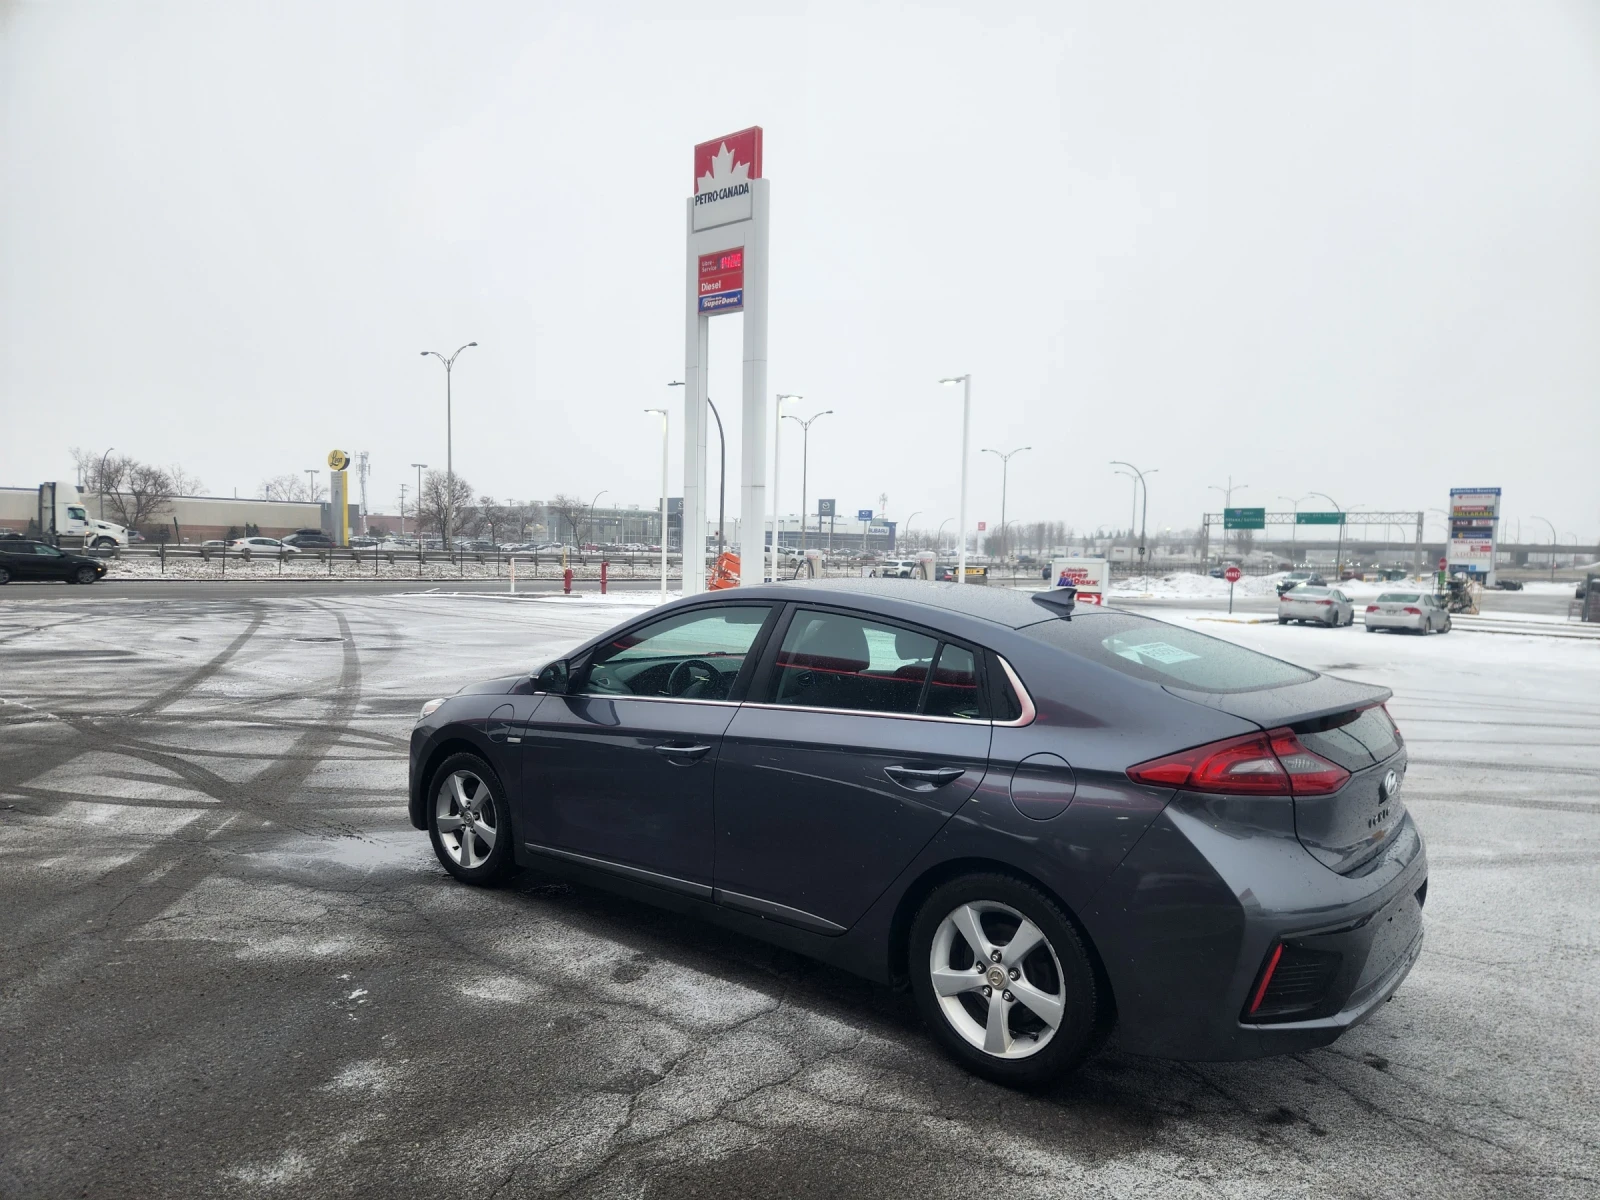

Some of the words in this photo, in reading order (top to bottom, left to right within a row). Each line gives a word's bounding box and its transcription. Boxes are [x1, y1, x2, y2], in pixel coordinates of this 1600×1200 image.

[701, 280, 721, 291] Diesel
[1060, 571, 1088, 579] Super
[1074, 578, 1098, 586] Doux
